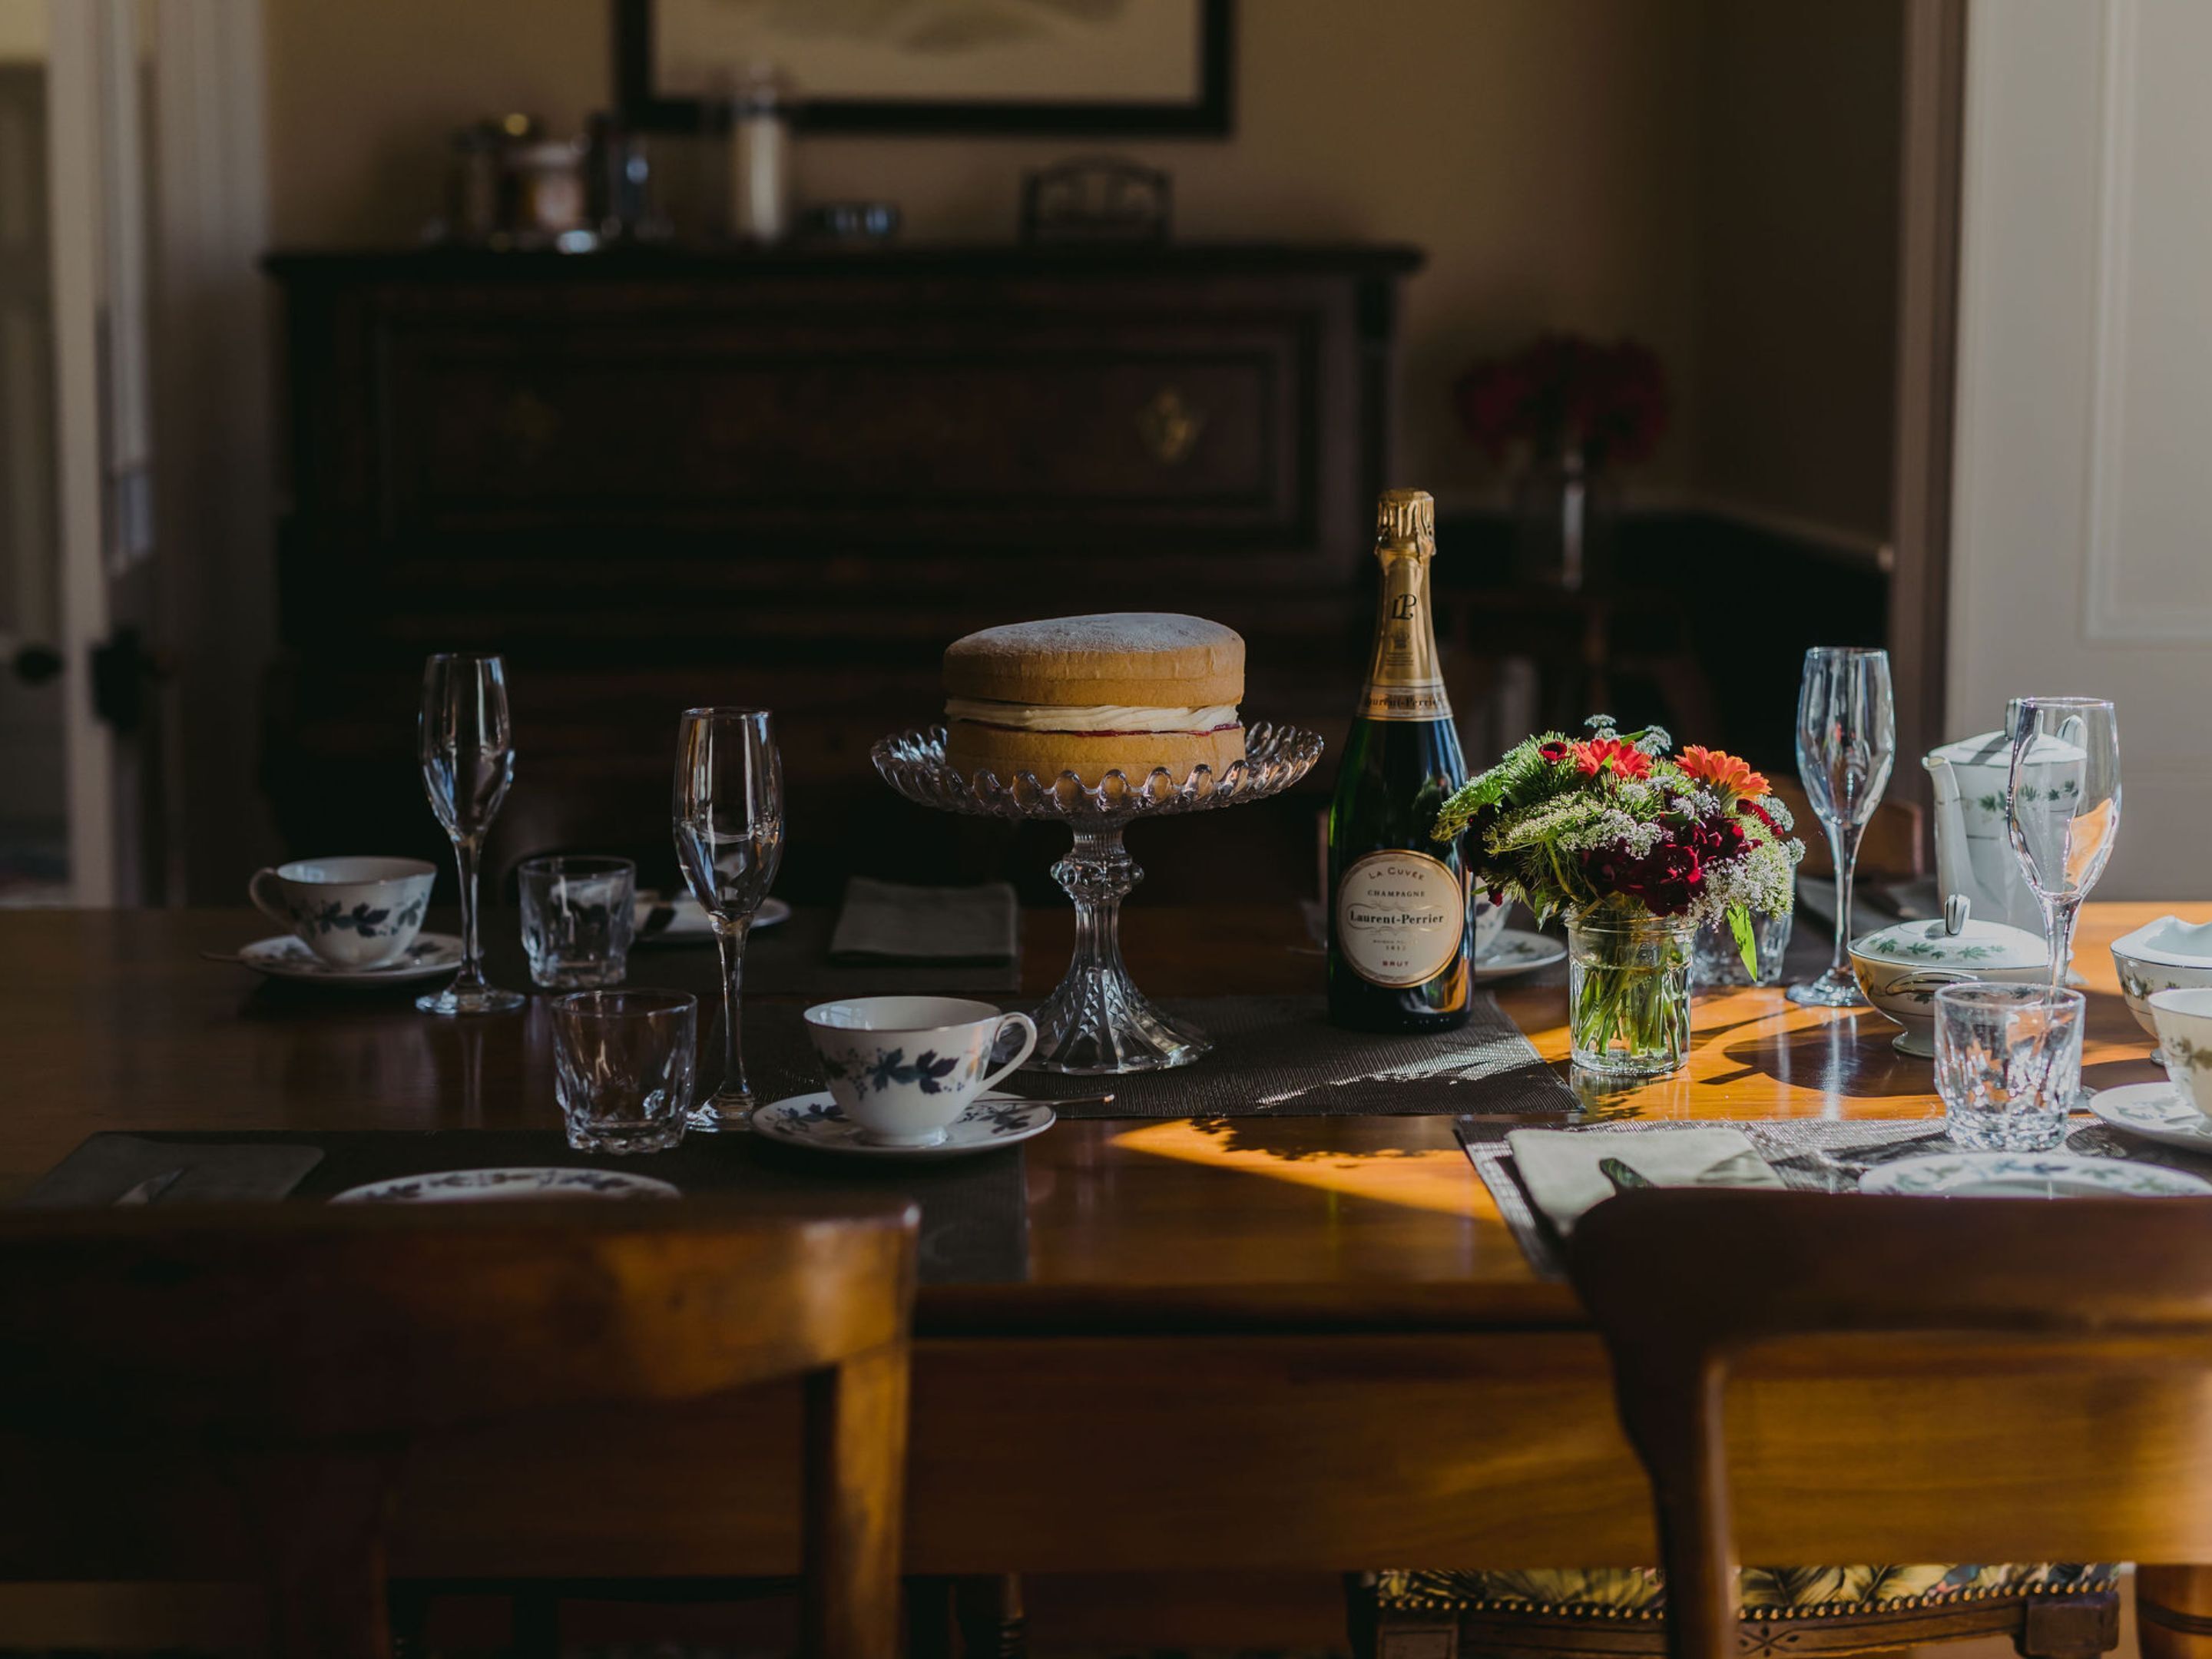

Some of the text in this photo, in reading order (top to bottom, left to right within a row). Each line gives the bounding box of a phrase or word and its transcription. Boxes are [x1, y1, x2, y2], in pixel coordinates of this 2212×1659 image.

[1368, 871, 1382, 879] LA
[1367, 889, 1426, 898] CHAMPAGNE
[1349, 910, 1444, 924] Laurent-Perrier
